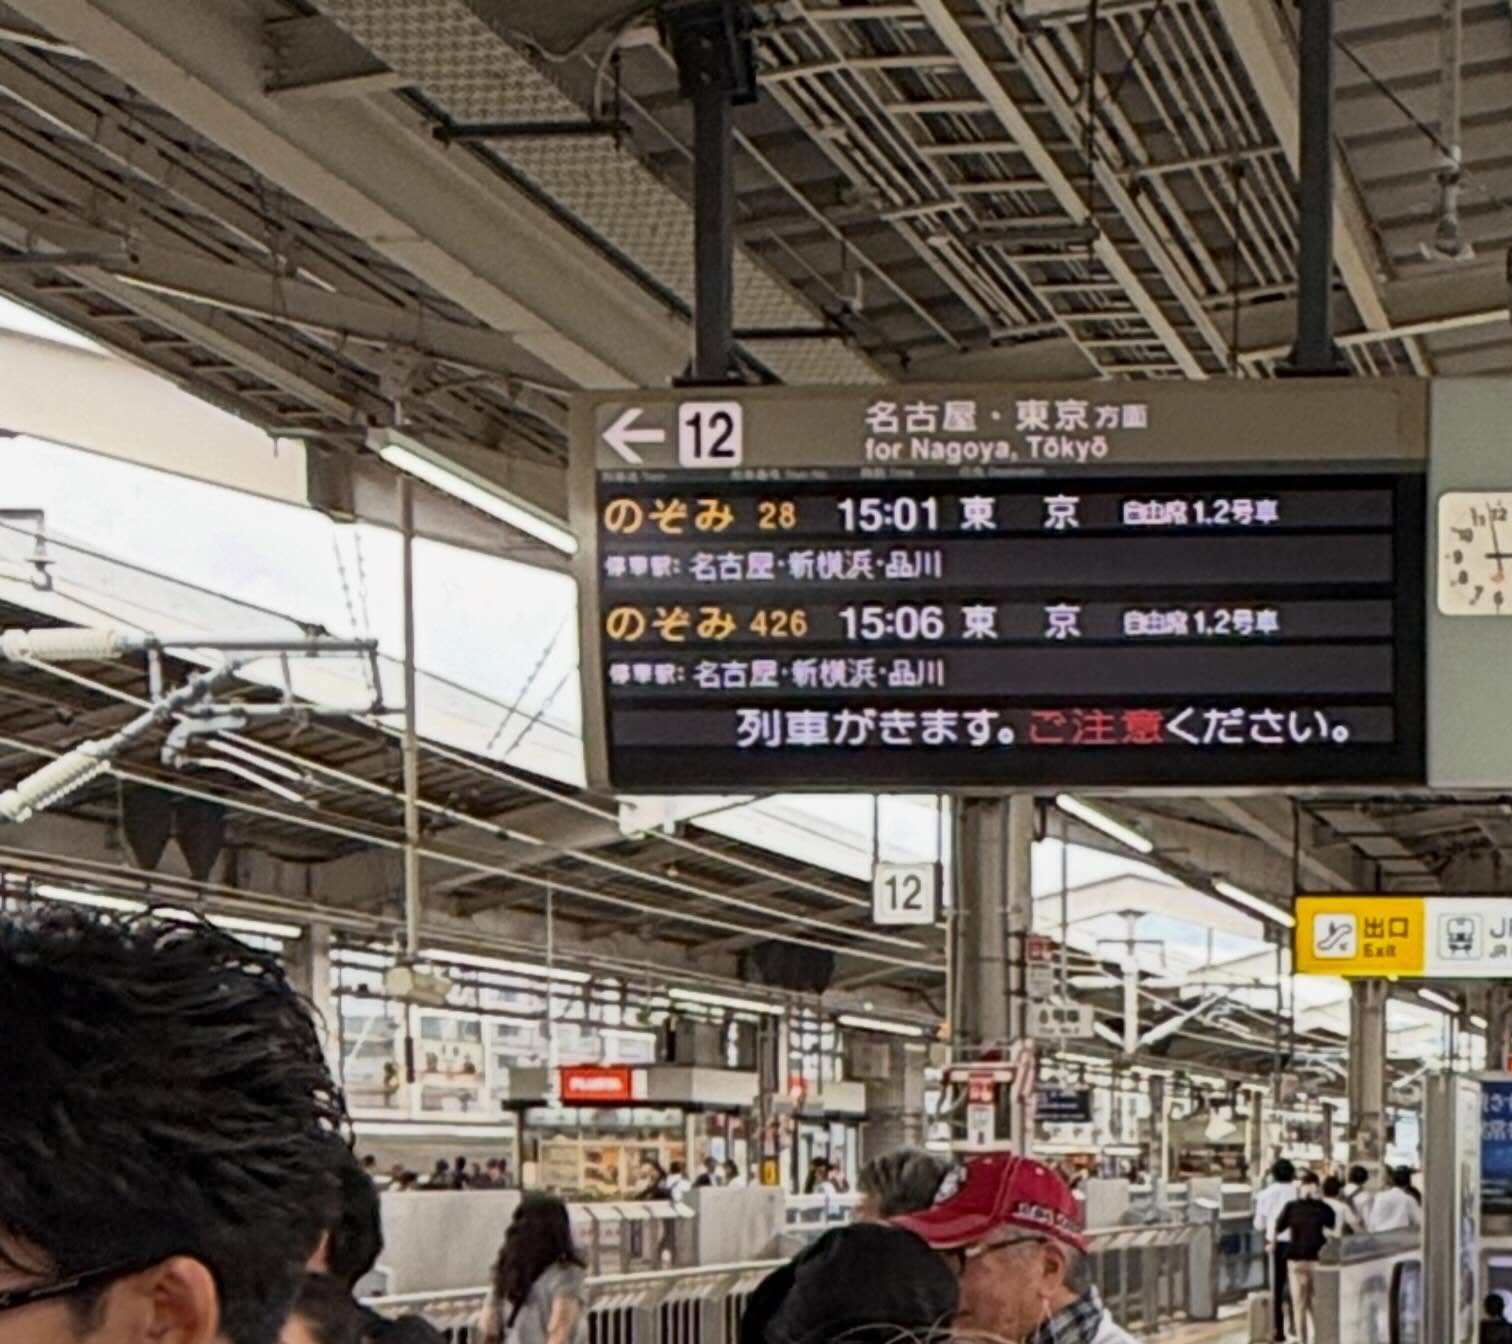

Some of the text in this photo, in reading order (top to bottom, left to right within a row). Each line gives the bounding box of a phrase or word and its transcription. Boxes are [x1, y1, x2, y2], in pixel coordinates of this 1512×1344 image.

[685, 412, 735, 459] 12
[865, 438, 901, 461] for
[910, 437, 1017, 465] Nagoya,
[604, 499, 734, 534] のぞみ
[758, 502, 796, 529] 28
[838, 497, 938, 531] 15:01
[606, 606, 737, 642] のぞみ
[749, 610, 808, 637] 426
[840, 606, 944, 640] 15:06
[885, 874, 923, 911] 12
[1364, 917, 1409, 939] 出口
[1363, 943, 1397, 958] Exit
